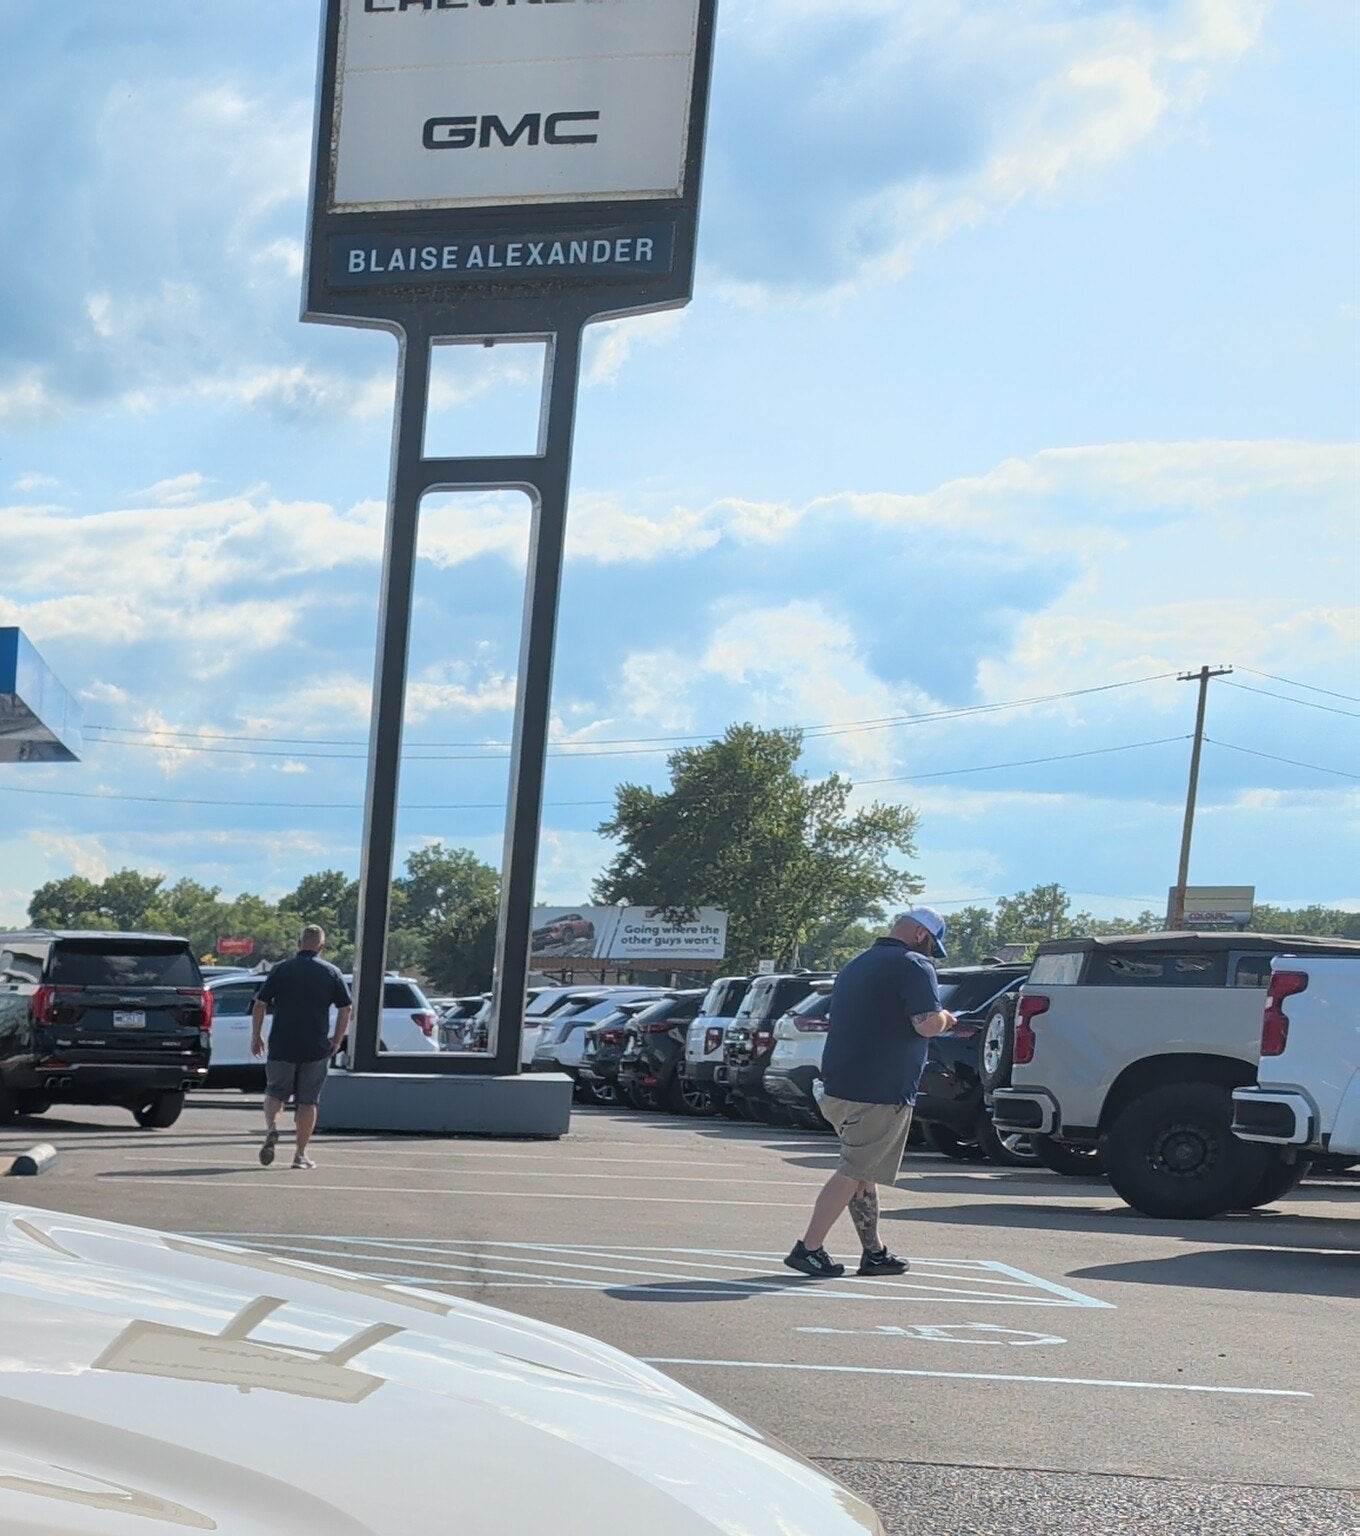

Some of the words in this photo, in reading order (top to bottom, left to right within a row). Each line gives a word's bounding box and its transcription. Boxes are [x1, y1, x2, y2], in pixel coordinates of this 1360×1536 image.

[422, 110, 600, 150] GMC
[347, 245, 459, 274] BLAISE
[466, 237, 654, 270] ALEXANDER
[621, 936, 651, 945] other
[654, 937, 681, 947] guys
[624, 924, 660, 936] Going
[662, 924, 698, 934] where
[700, 924, 720, 934] the
